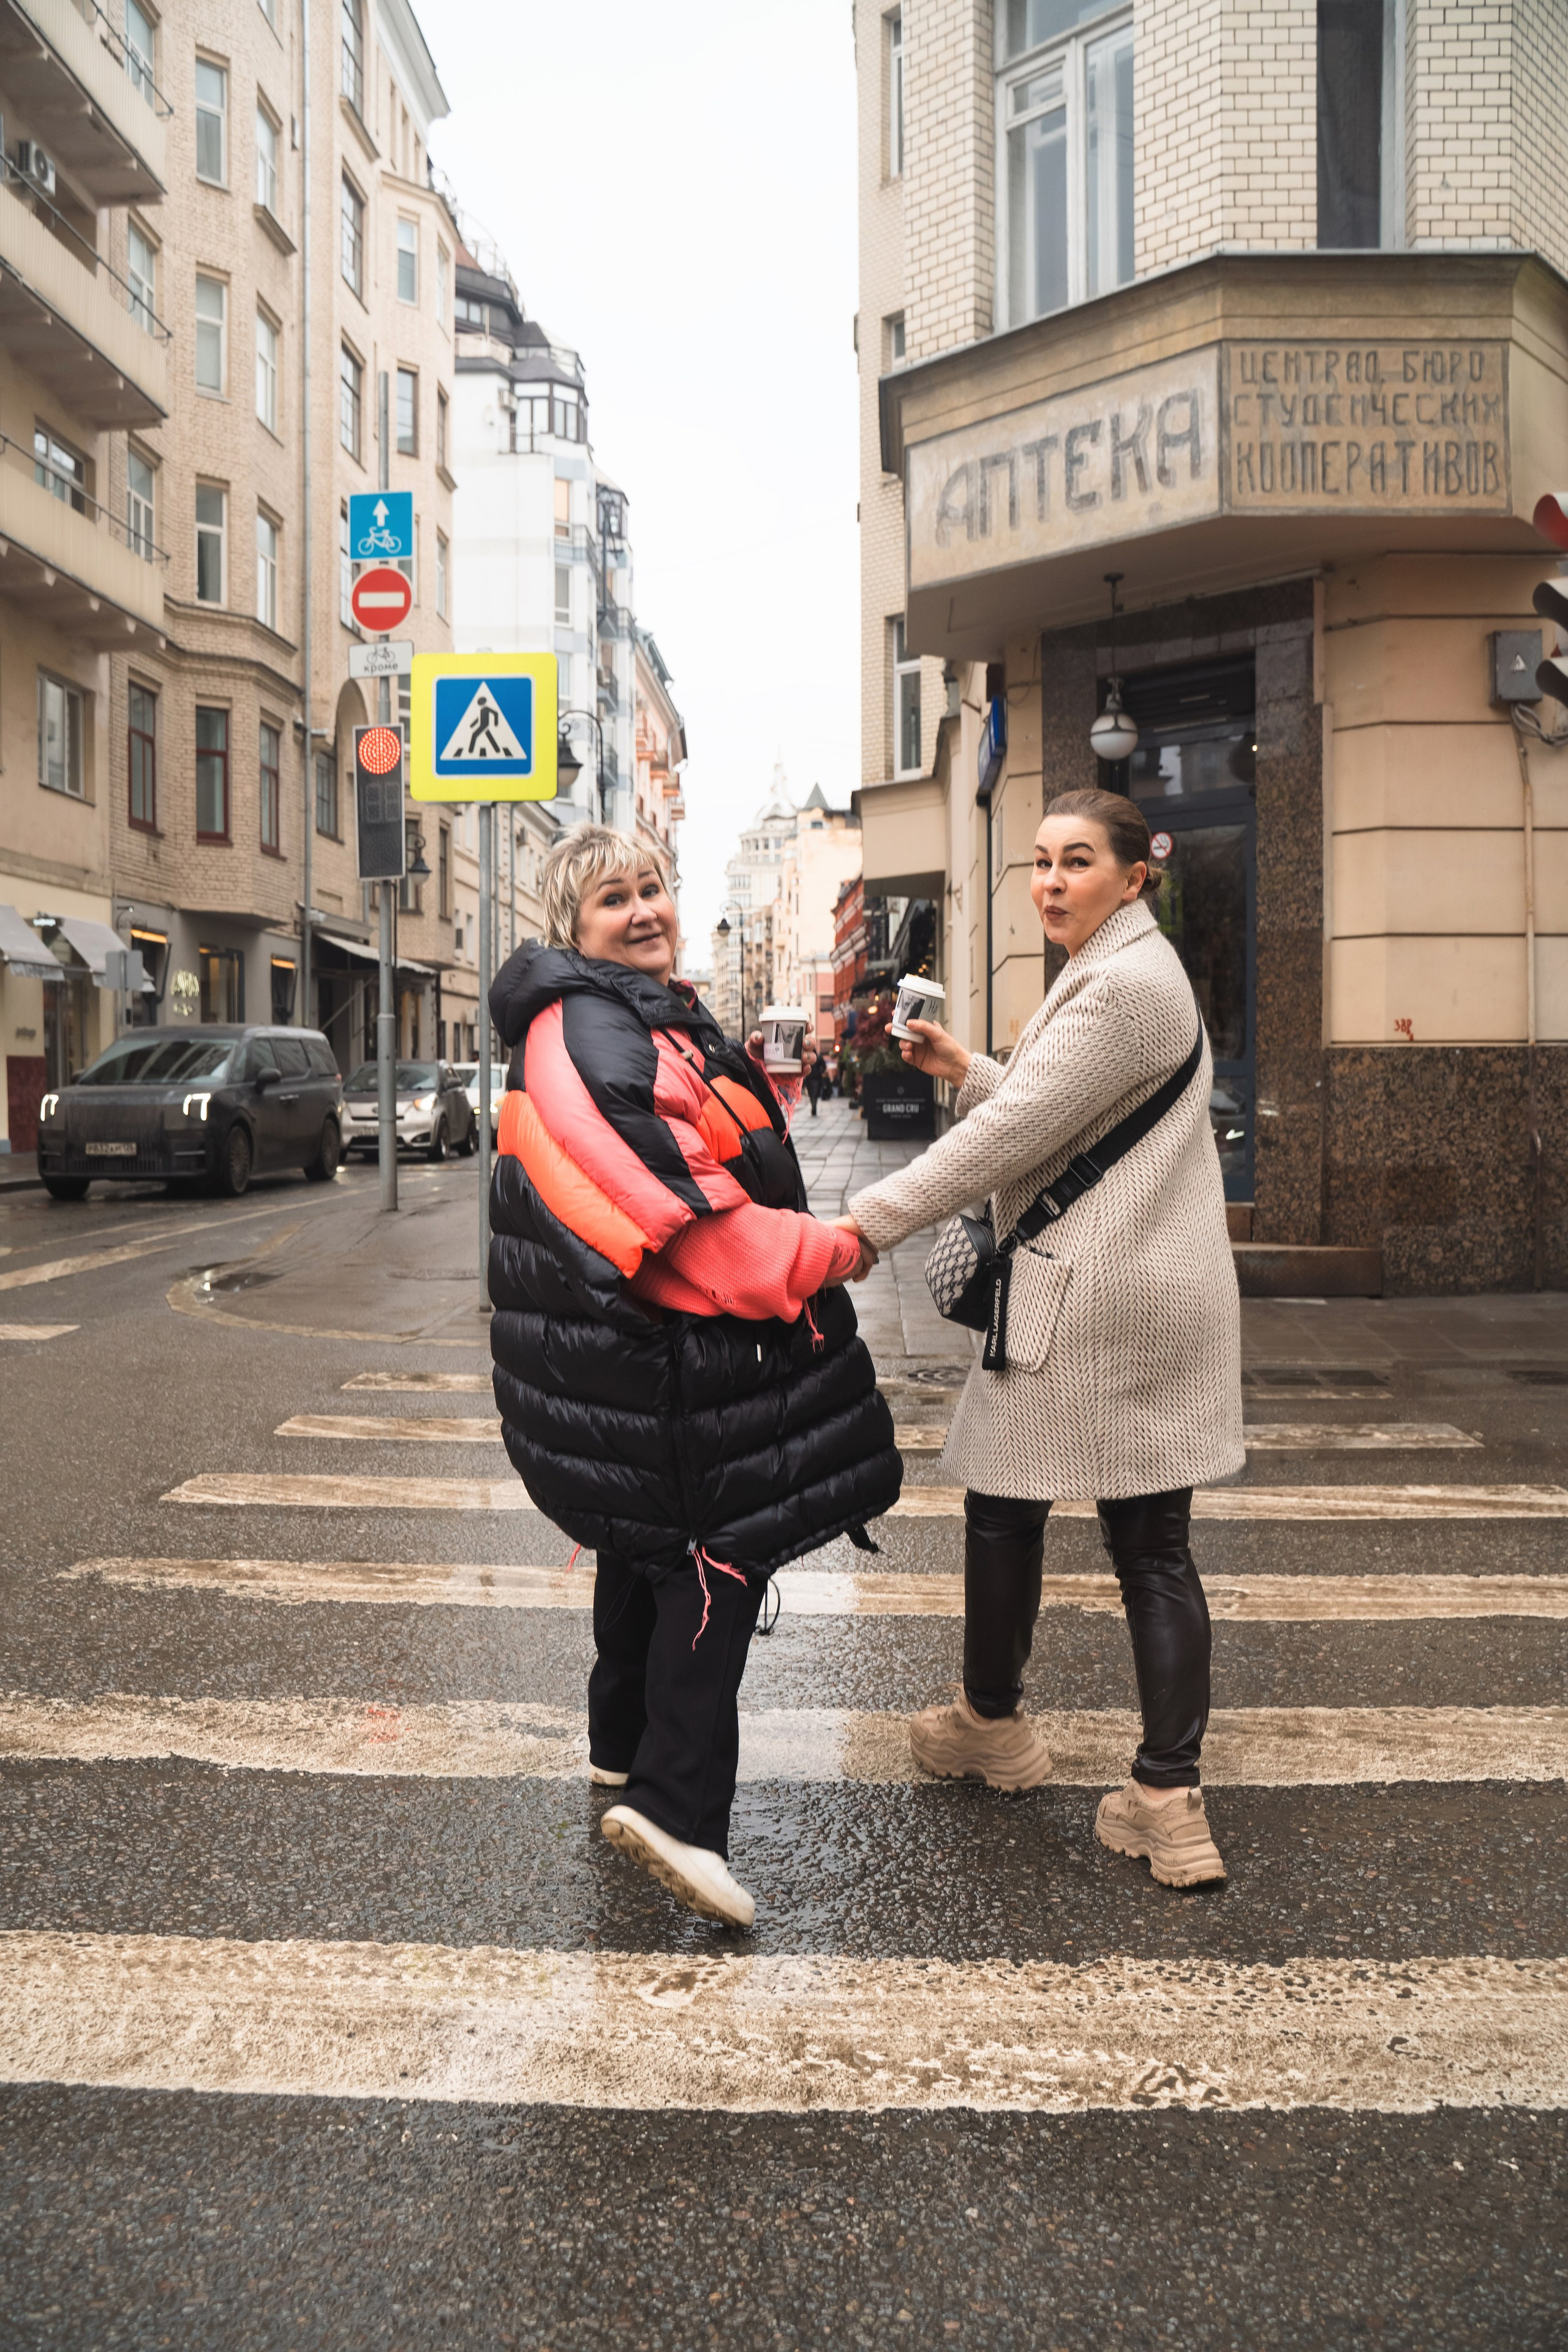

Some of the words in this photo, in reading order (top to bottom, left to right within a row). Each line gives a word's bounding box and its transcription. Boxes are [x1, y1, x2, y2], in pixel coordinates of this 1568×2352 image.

[1402, 350, 1485, 384] БЮРО
[1233, 393, 1501, 428] СТУДЕНЧЕСКИХ
[935, 386, 1204, 548] АПТЕКА
[1236, 440, 1501, 496] КООПЕРАТИВОВ
[363, 663, 398, 674] кроме
[882, 1104, 905, 1114] GRAND
[905, 1104, 919, 1114] CRU
[993, 1278, 1002, 1332] LAGERFELD
[989, 1332, 998, 1357] KARL
